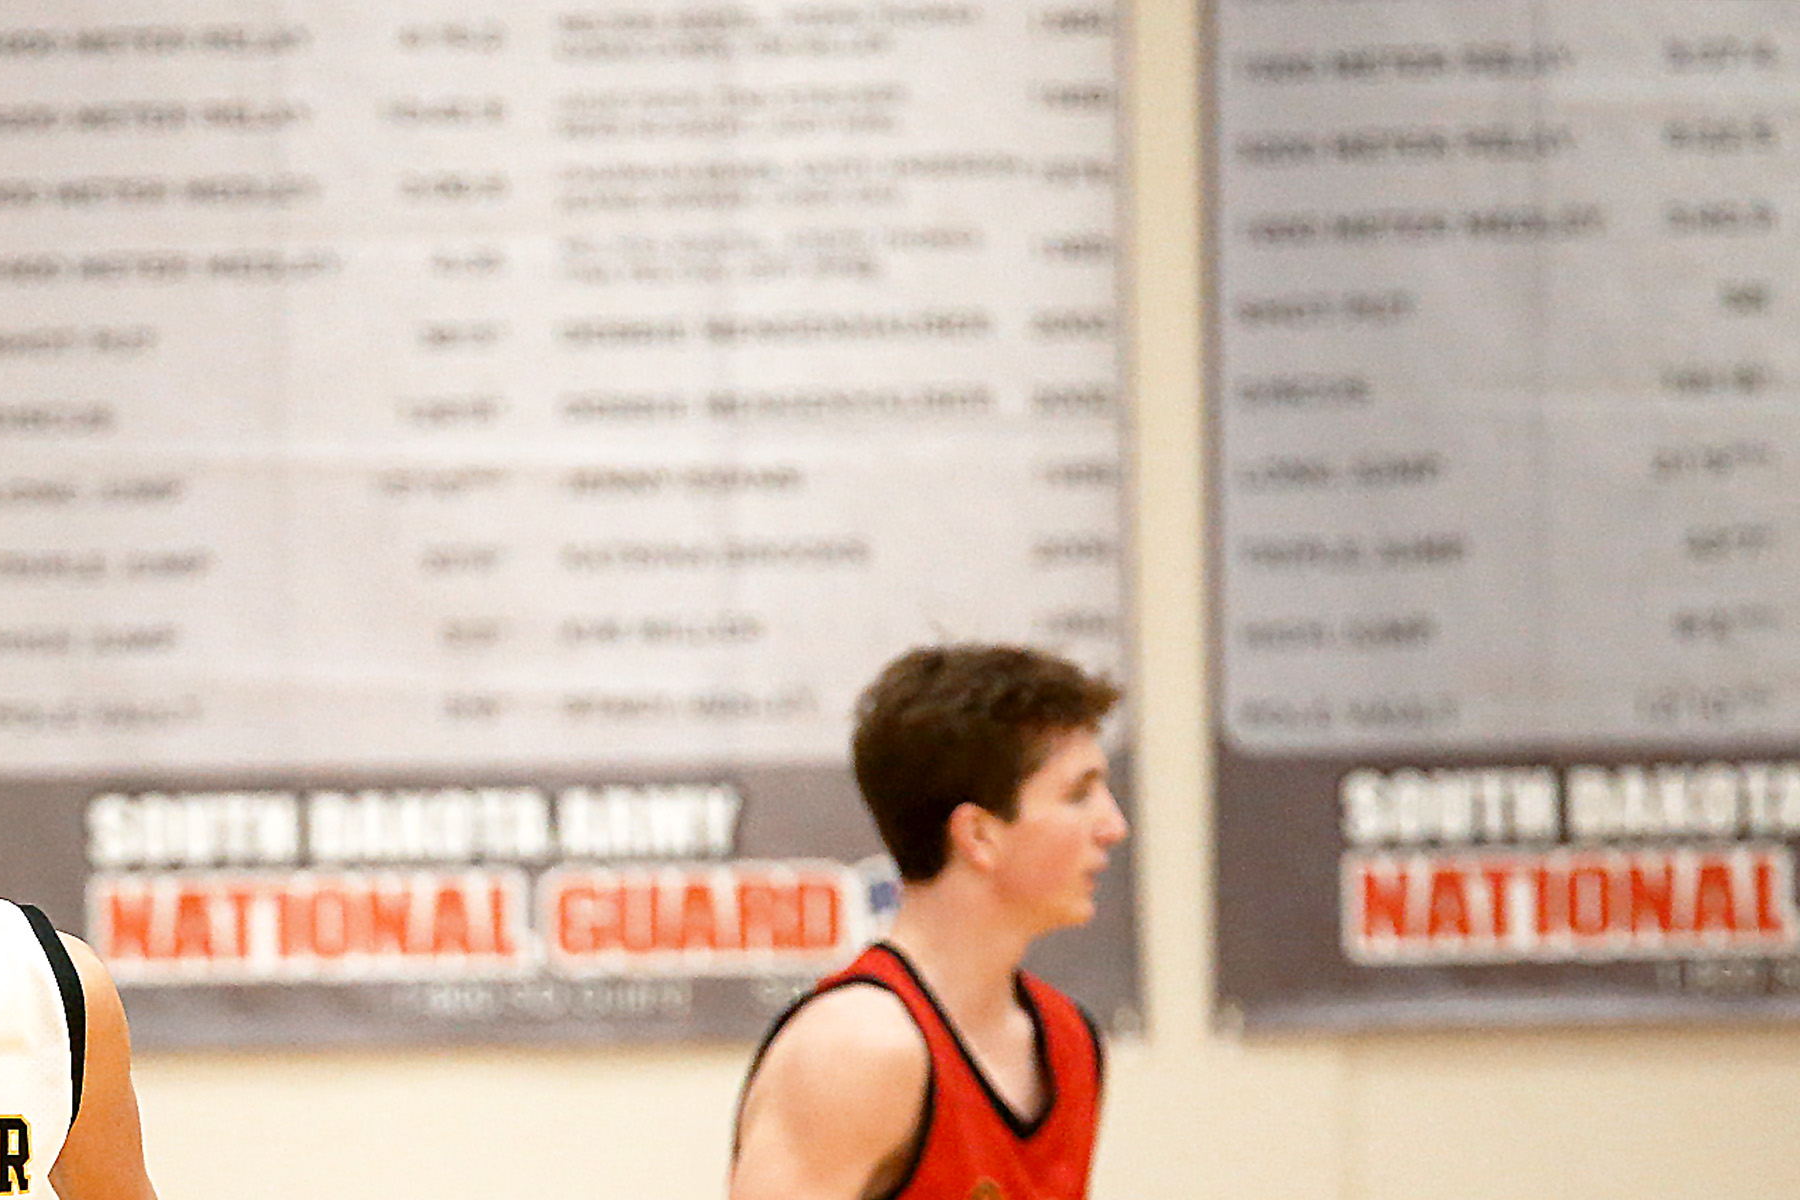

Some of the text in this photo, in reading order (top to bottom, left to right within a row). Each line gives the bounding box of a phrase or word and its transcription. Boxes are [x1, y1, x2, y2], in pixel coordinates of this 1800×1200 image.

[110, 882, 840, 958] NATIONAL GUARD
[1363, 860, 1784, 938] NATIONAL
